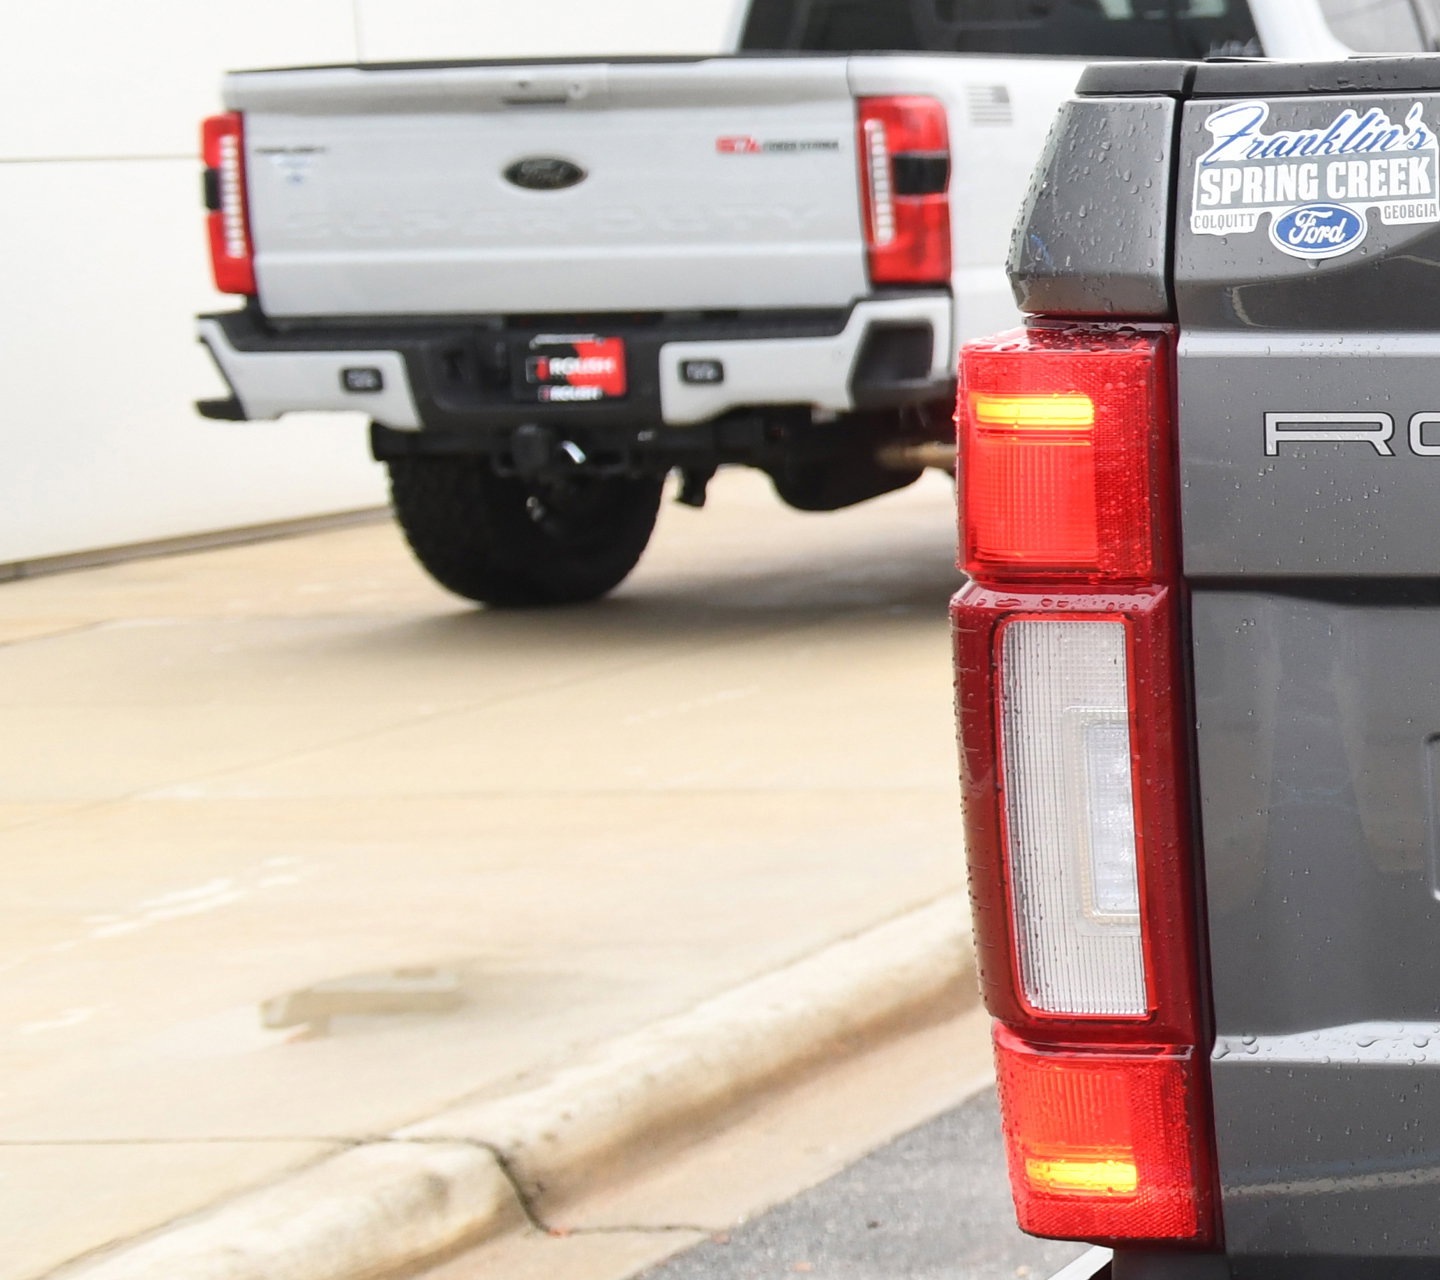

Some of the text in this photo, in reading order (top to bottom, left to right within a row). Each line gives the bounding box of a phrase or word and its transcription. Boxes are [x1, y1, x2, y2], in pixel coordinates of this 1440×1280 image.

[1201, 106, 1434, 166] Franklin's
[1201, 156, 1432, 205] SPRING CREEK
[1194, 213, 1255, 230] COLQUITT
[1289, 209, 1347, 244] Ford
[1384, 203, 1438, 219] GEORGIA
